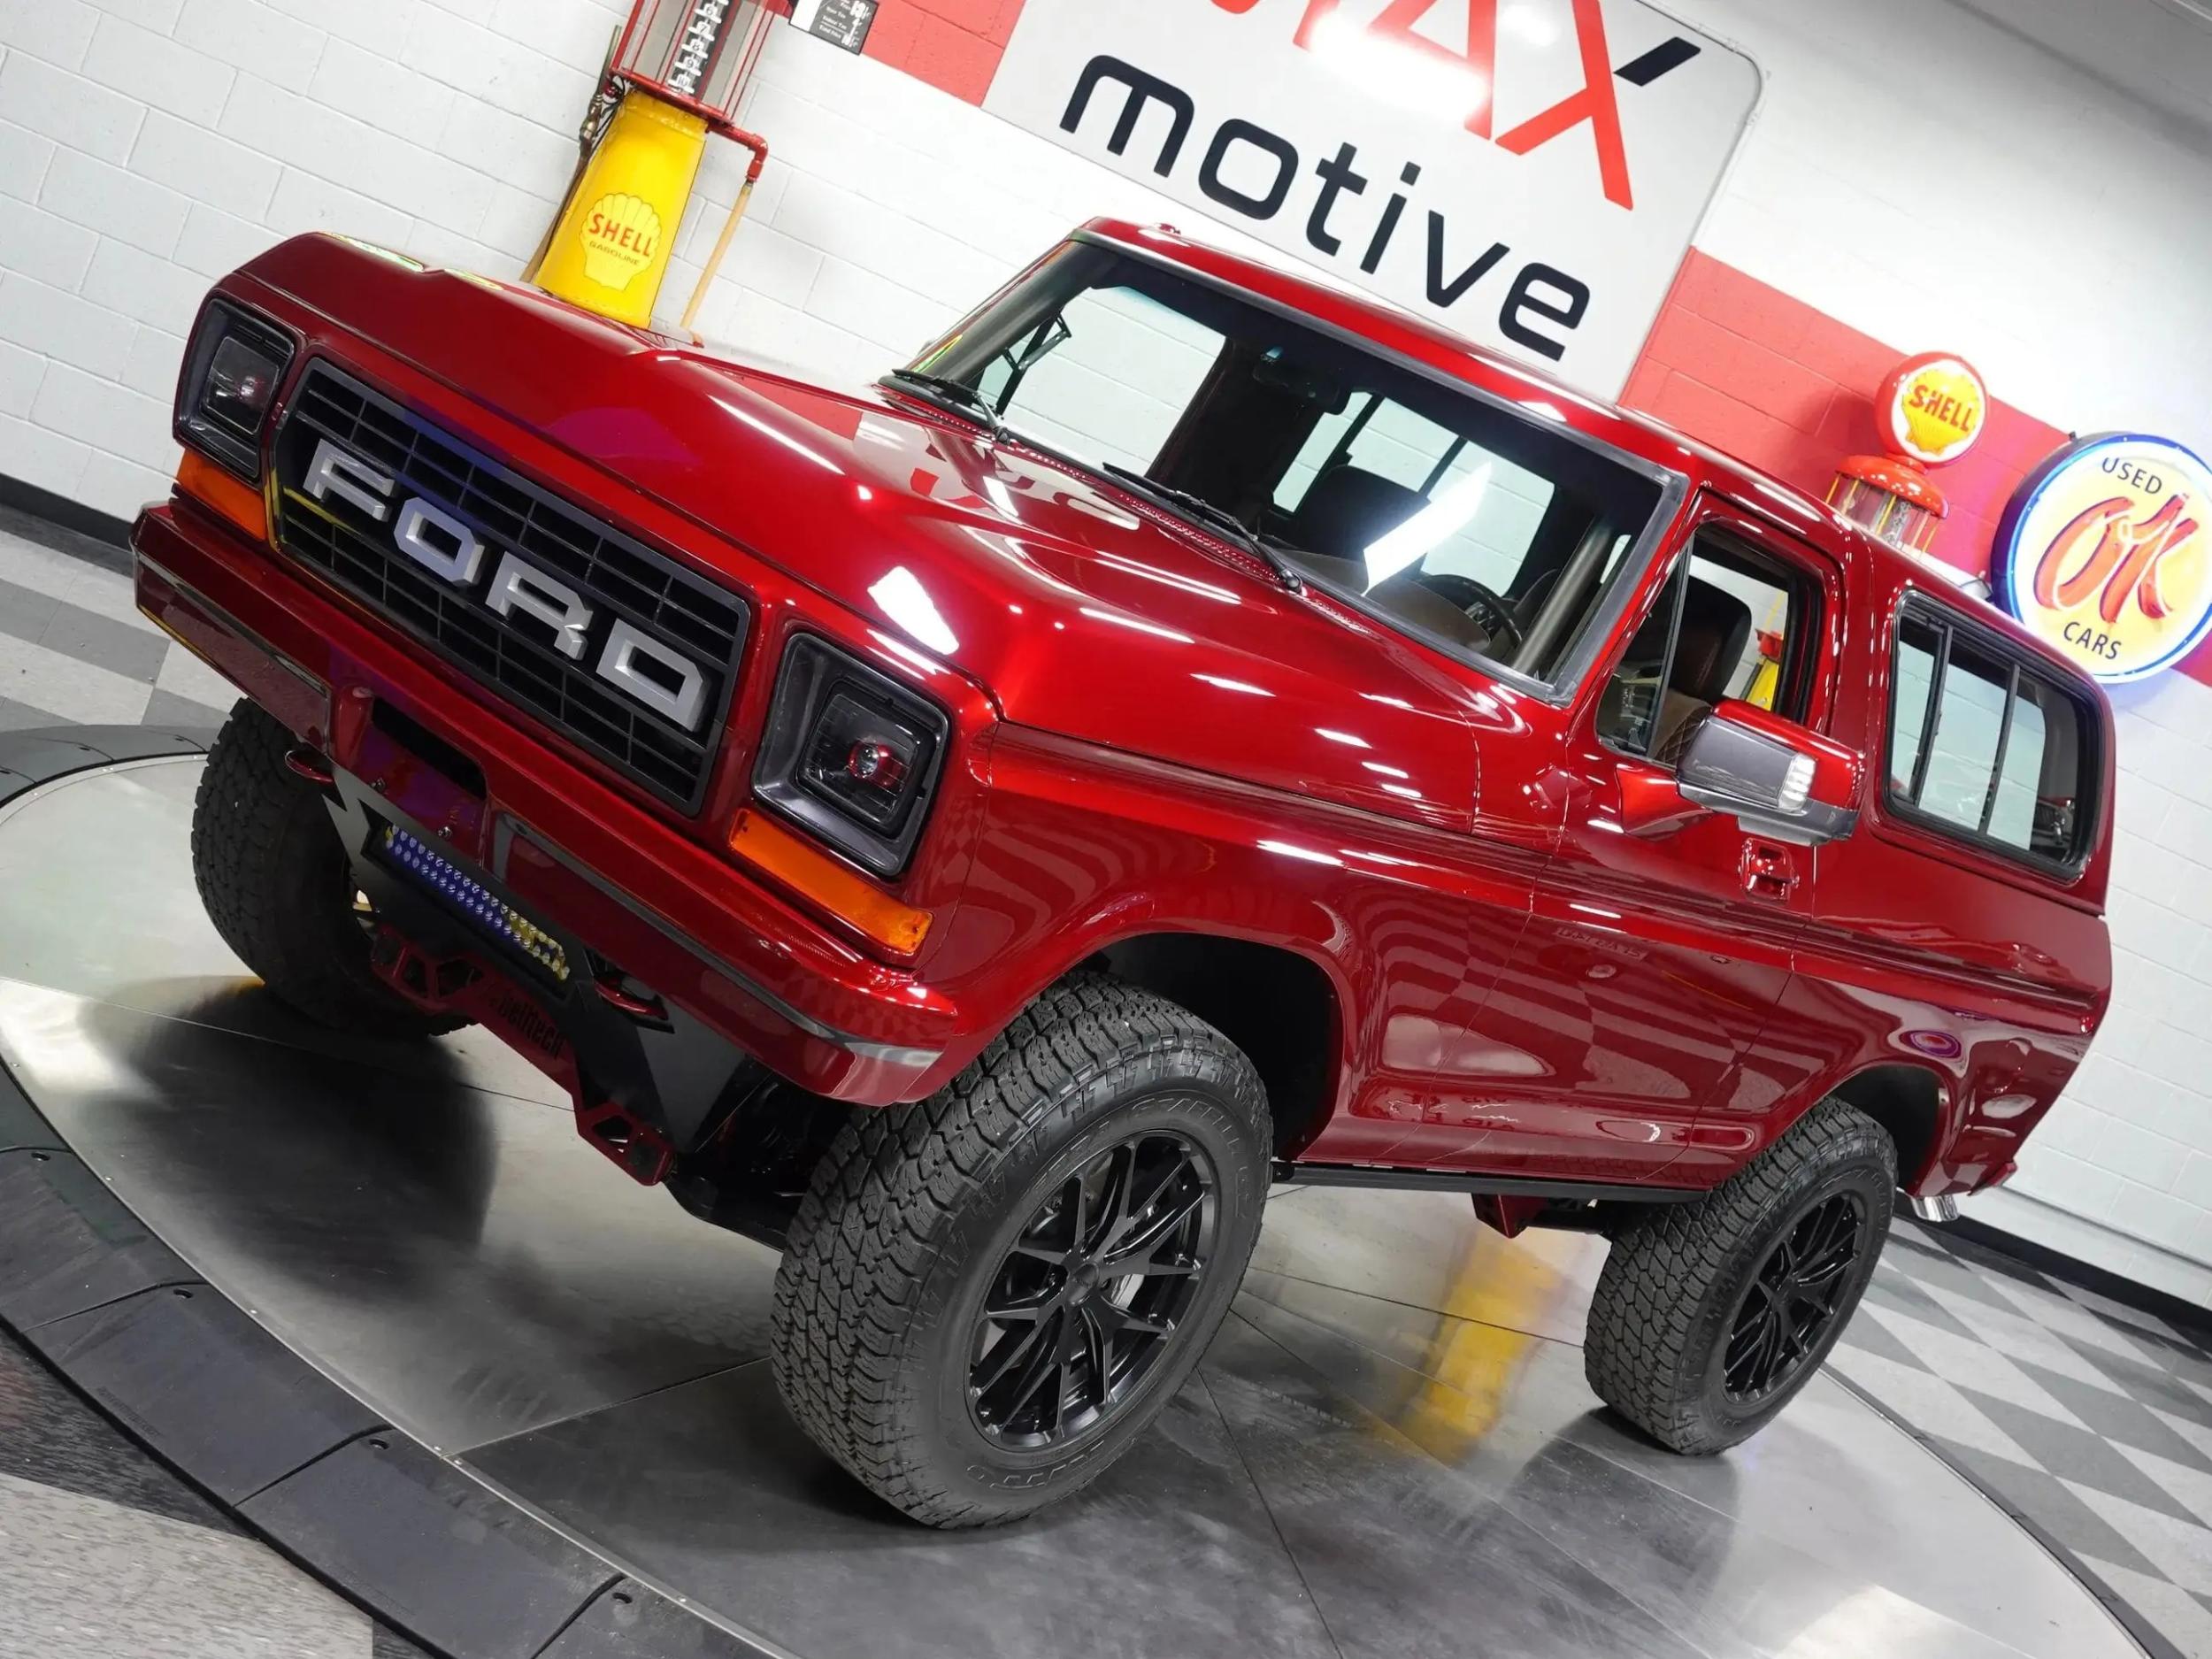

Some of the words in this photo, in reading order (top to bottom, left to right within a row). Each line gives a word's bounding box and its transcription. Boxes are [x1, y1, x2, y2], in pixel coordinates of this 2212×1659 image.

[1059, 55, 1590, 361] motive
[588, 213, 652, 257] SHELL
[589, 241, 641, 265] GASOLINE
[1909, 384, 1972, 433] SHELL
[2101, 457, 2162, 495] USED
[2033, 493, 2199, 623] OK
[303, 438, 705, 733] FORD
[2063, 621, 2122, 659] CARS
